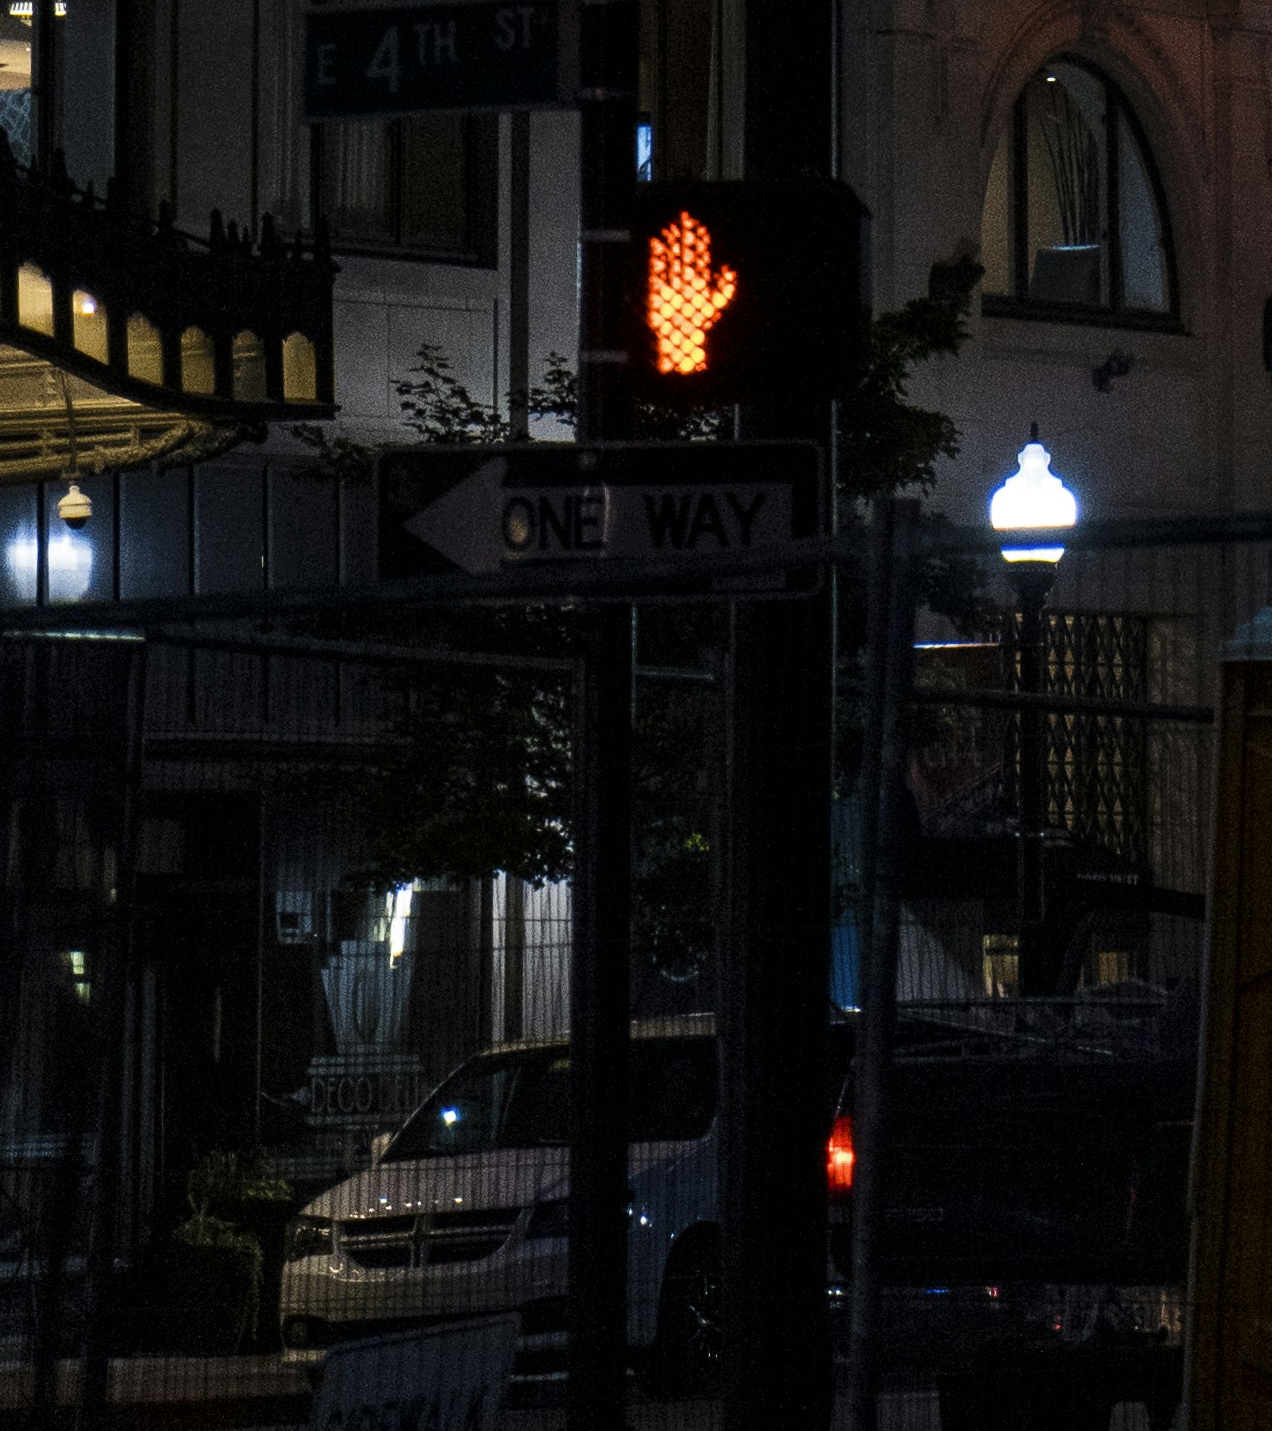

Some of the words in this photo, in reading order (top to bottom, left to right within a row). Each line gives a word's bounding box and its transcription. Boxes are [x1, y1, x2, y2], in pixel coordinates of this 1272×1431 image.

[316, 43, 337, 86] E
[365, 19, 457, 93] 4TH
[495, 6, 533, 50] ST
[503, 495, 603, 552] ONE
[644, 491, 767, 551] WAY
[310, 1075, 373, 1113] DECO
